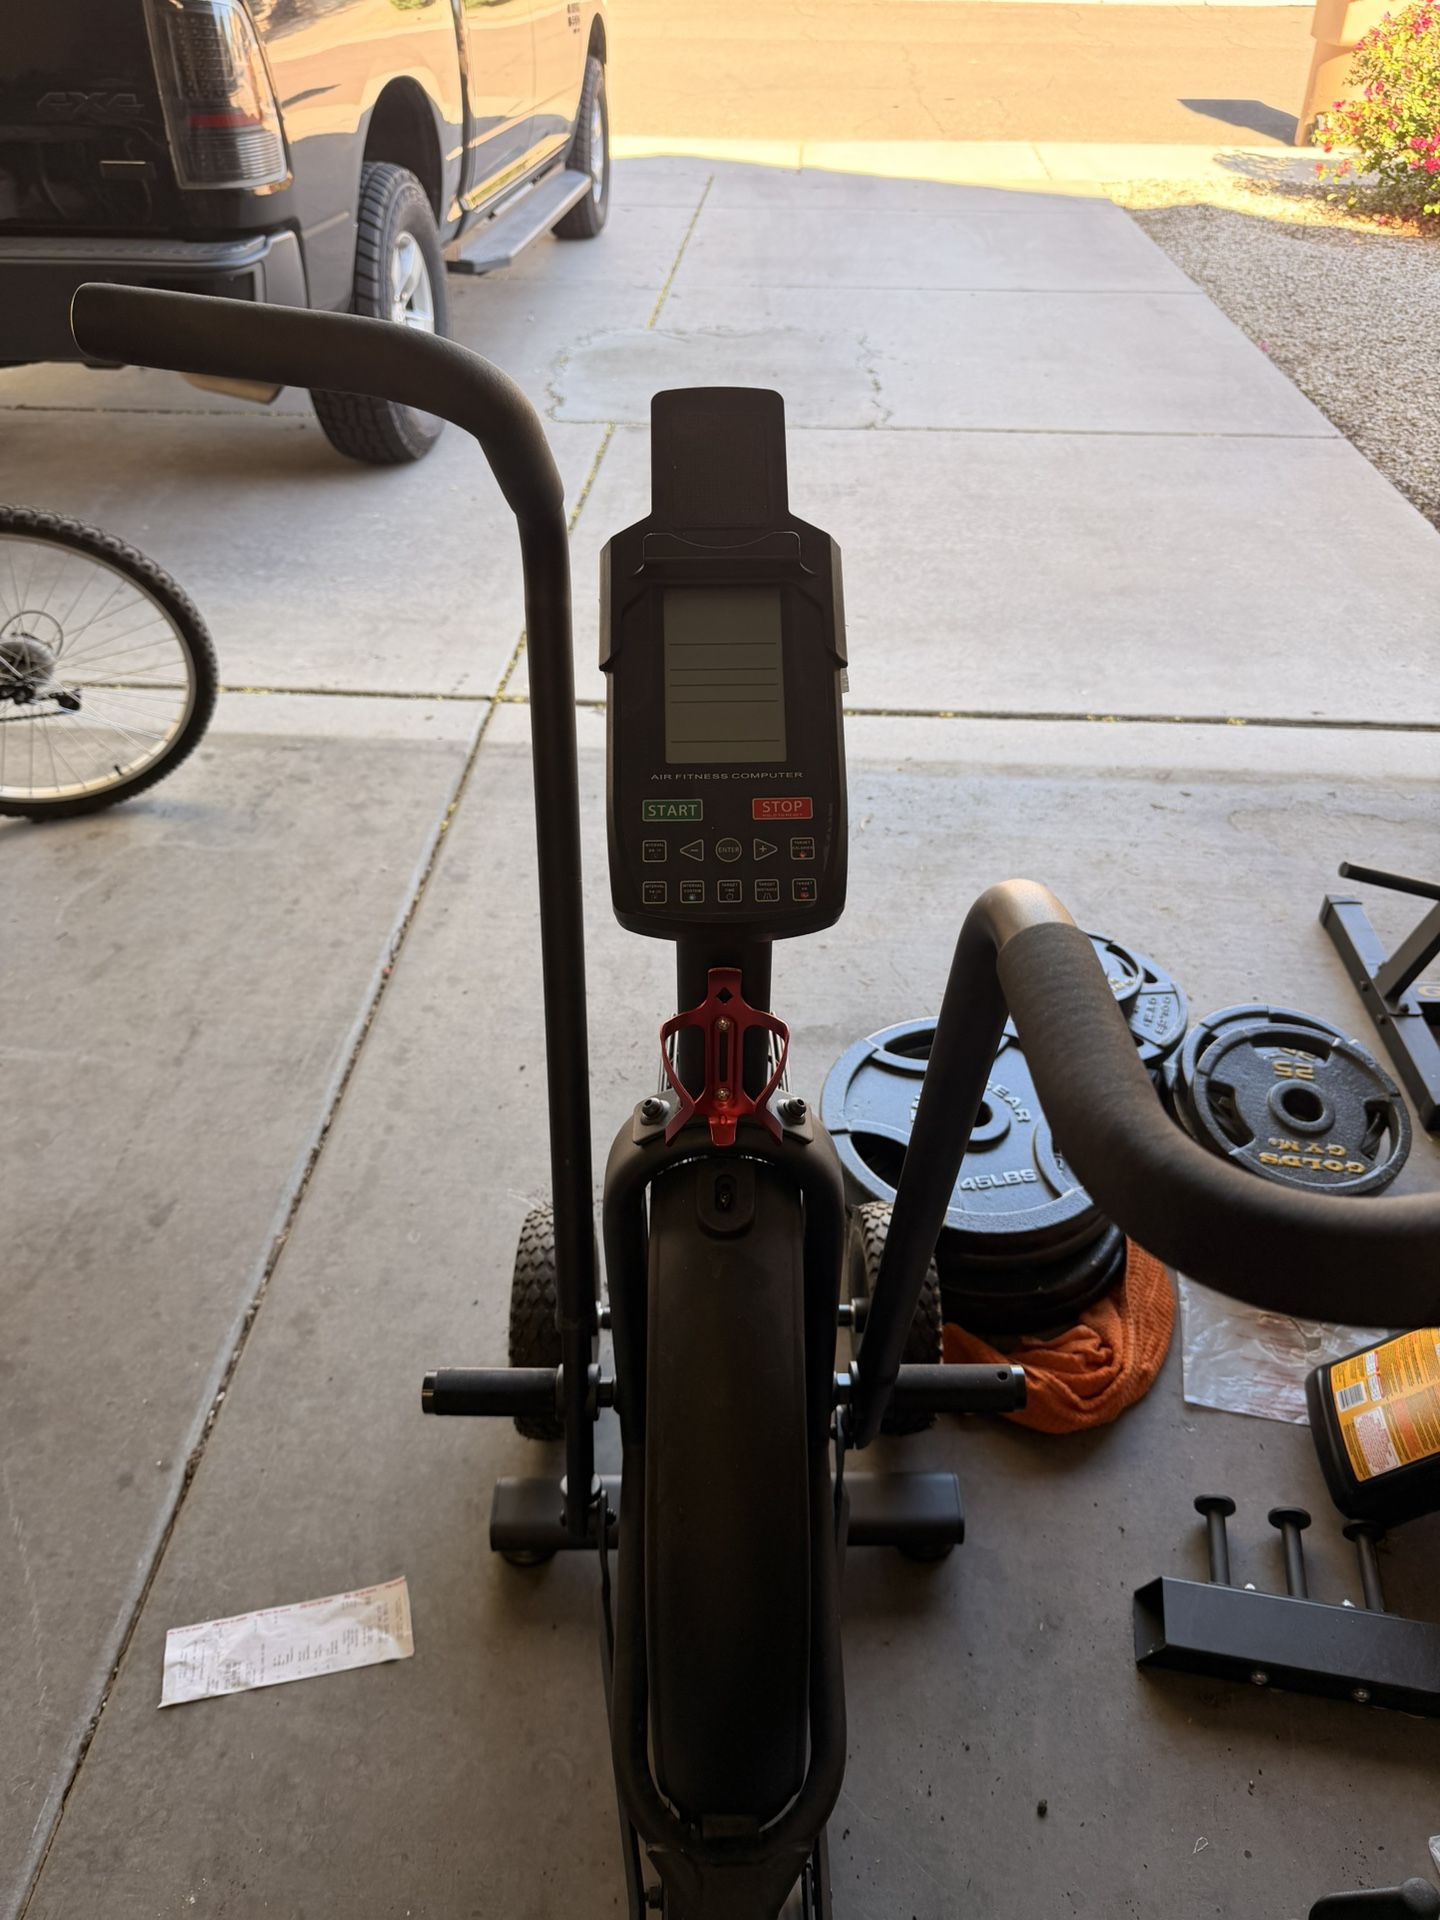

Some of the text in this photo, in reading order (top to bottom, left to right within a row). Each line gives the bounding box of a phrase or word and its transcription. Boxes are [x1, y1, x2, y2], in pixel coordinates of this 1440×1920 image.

[650, 771, 804, 781] AIR FITNESS COMPUTER
[647, 804, 698, 817] START
[762, 800, 803, 813] STOP
[718, 846, 740, 854] ENTER
[1273, 1061, 1314, 1081] 25
[960, 1169, 1038, 1192] 45LBS
